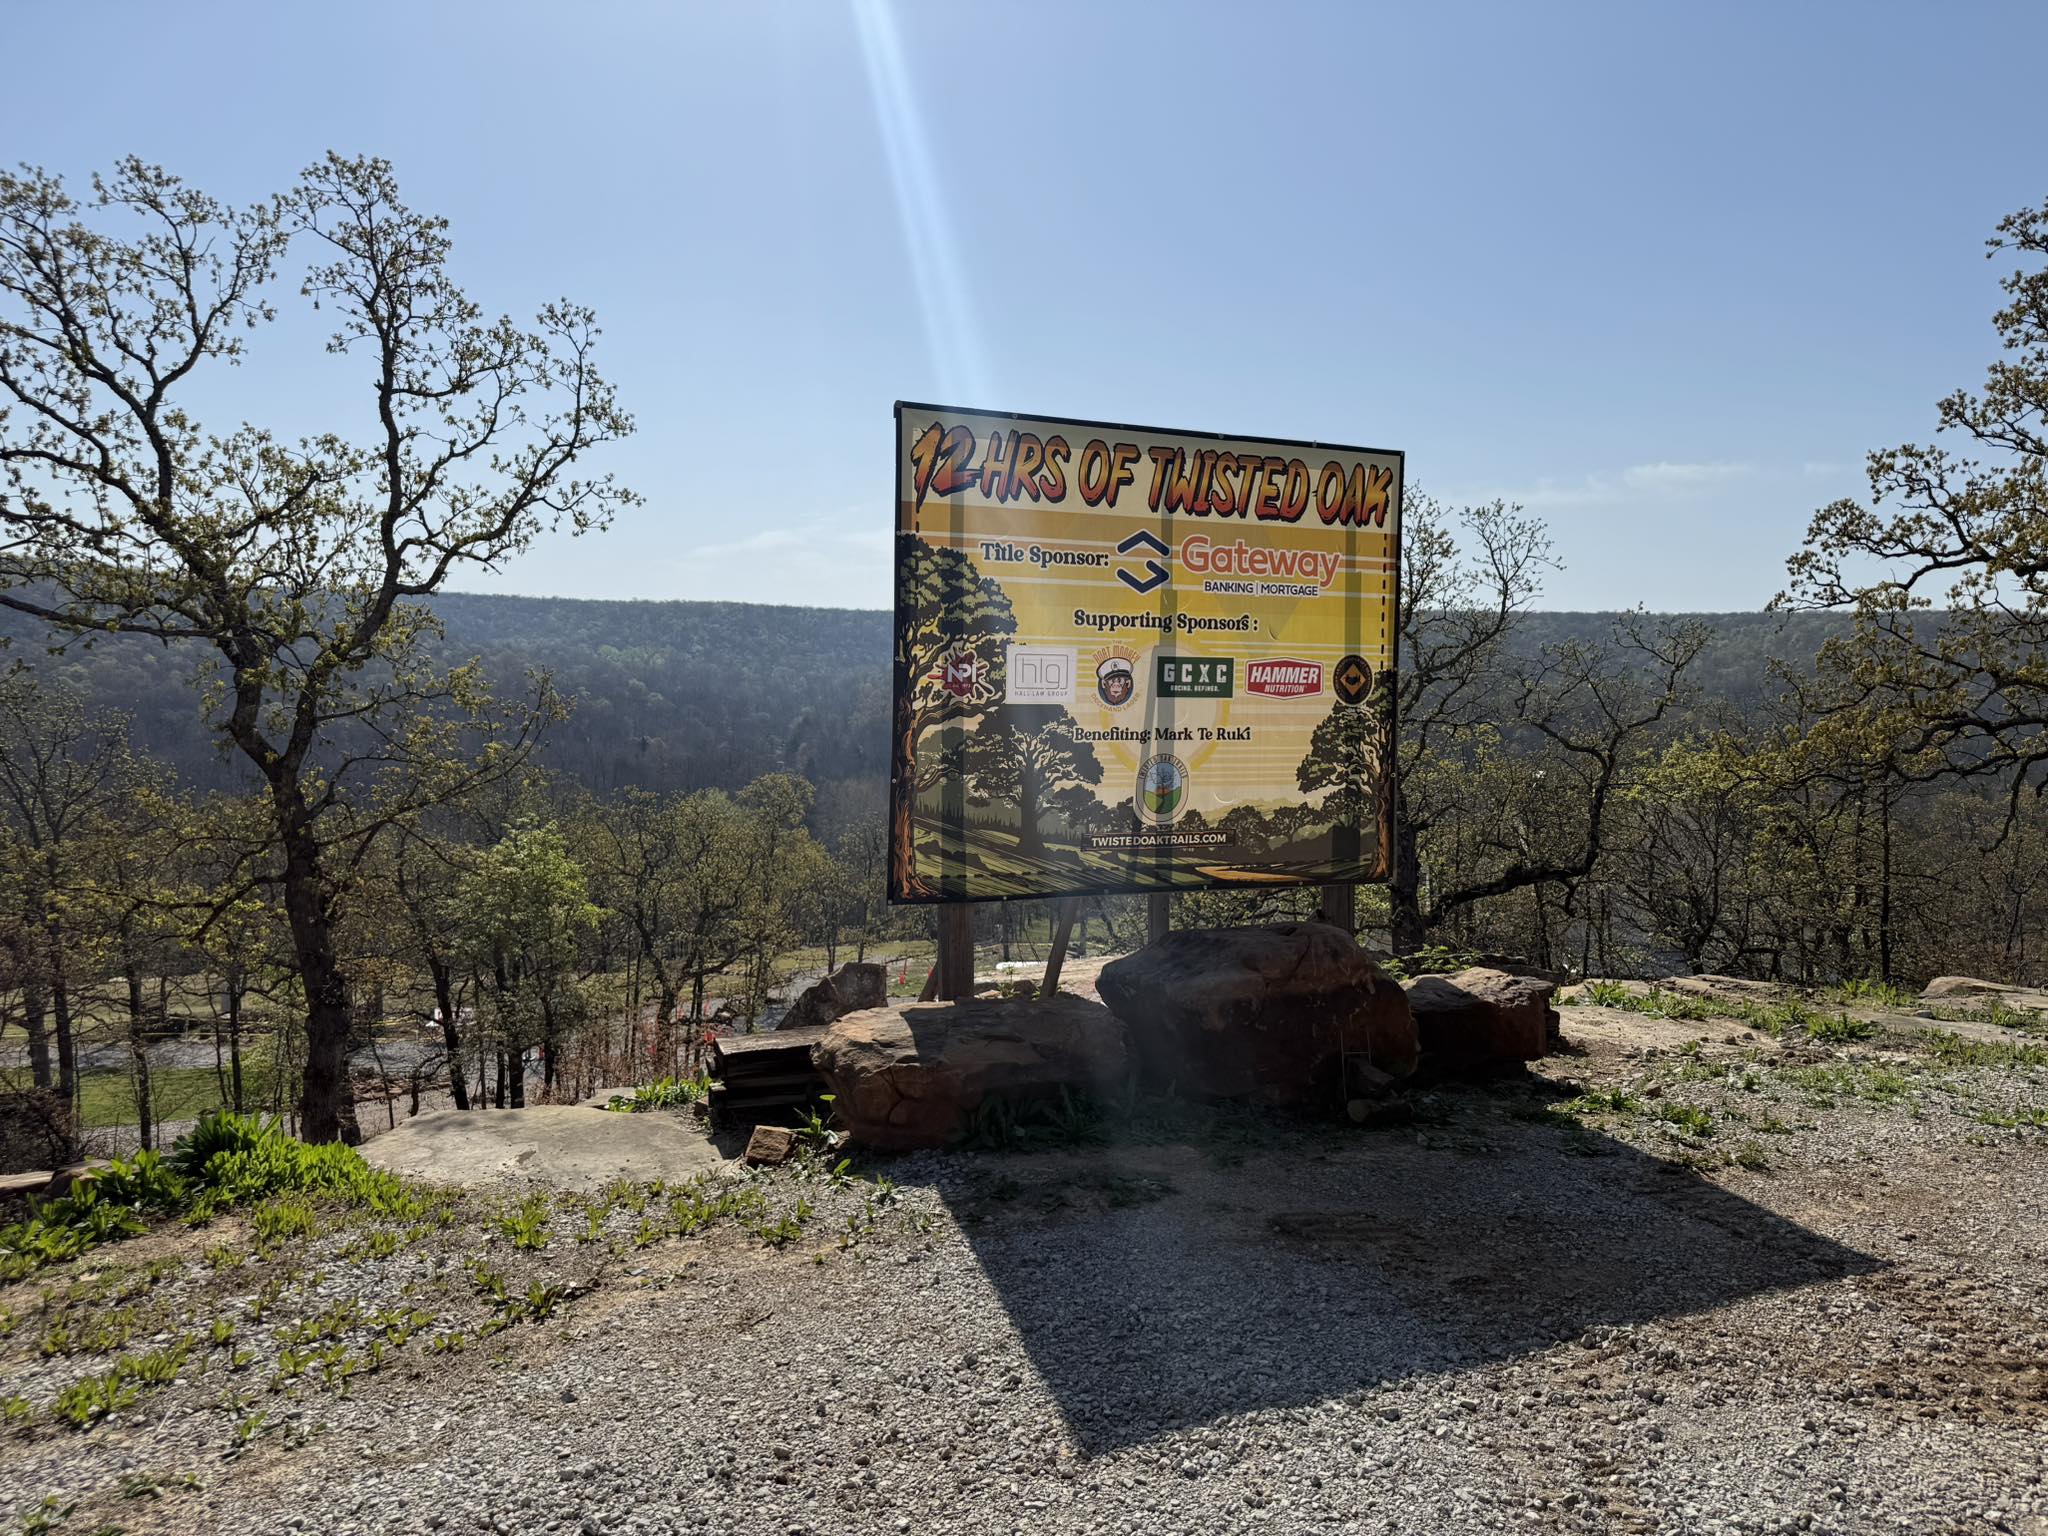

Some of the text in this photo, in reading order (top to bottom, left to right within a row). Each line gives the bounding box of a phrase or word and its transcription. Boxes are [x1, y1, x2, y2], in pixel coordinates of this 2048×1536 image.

[911, 421, 1393, 528] 12 HRS OF TWISTED OAK
[980, 541, 1109, 568] Title Sponsor:
[1181, 535, 1342, 588] Gateway
[1204, 581, 1318, 597] BANKING MORTGAGE
[1074, 609, 1172, 632] Supporting
[1163, 663, 1227, 683] GCXC
[1250, 666, 1320, 684] HAMMER
[1264, 684, 1305, 693] NUTRITION
[1073, 726, 1251, 744] Benefiting: Mark Te Ruki
[1091, 833, 1227, 848] TWISTEDOAKTRAILS.COM
